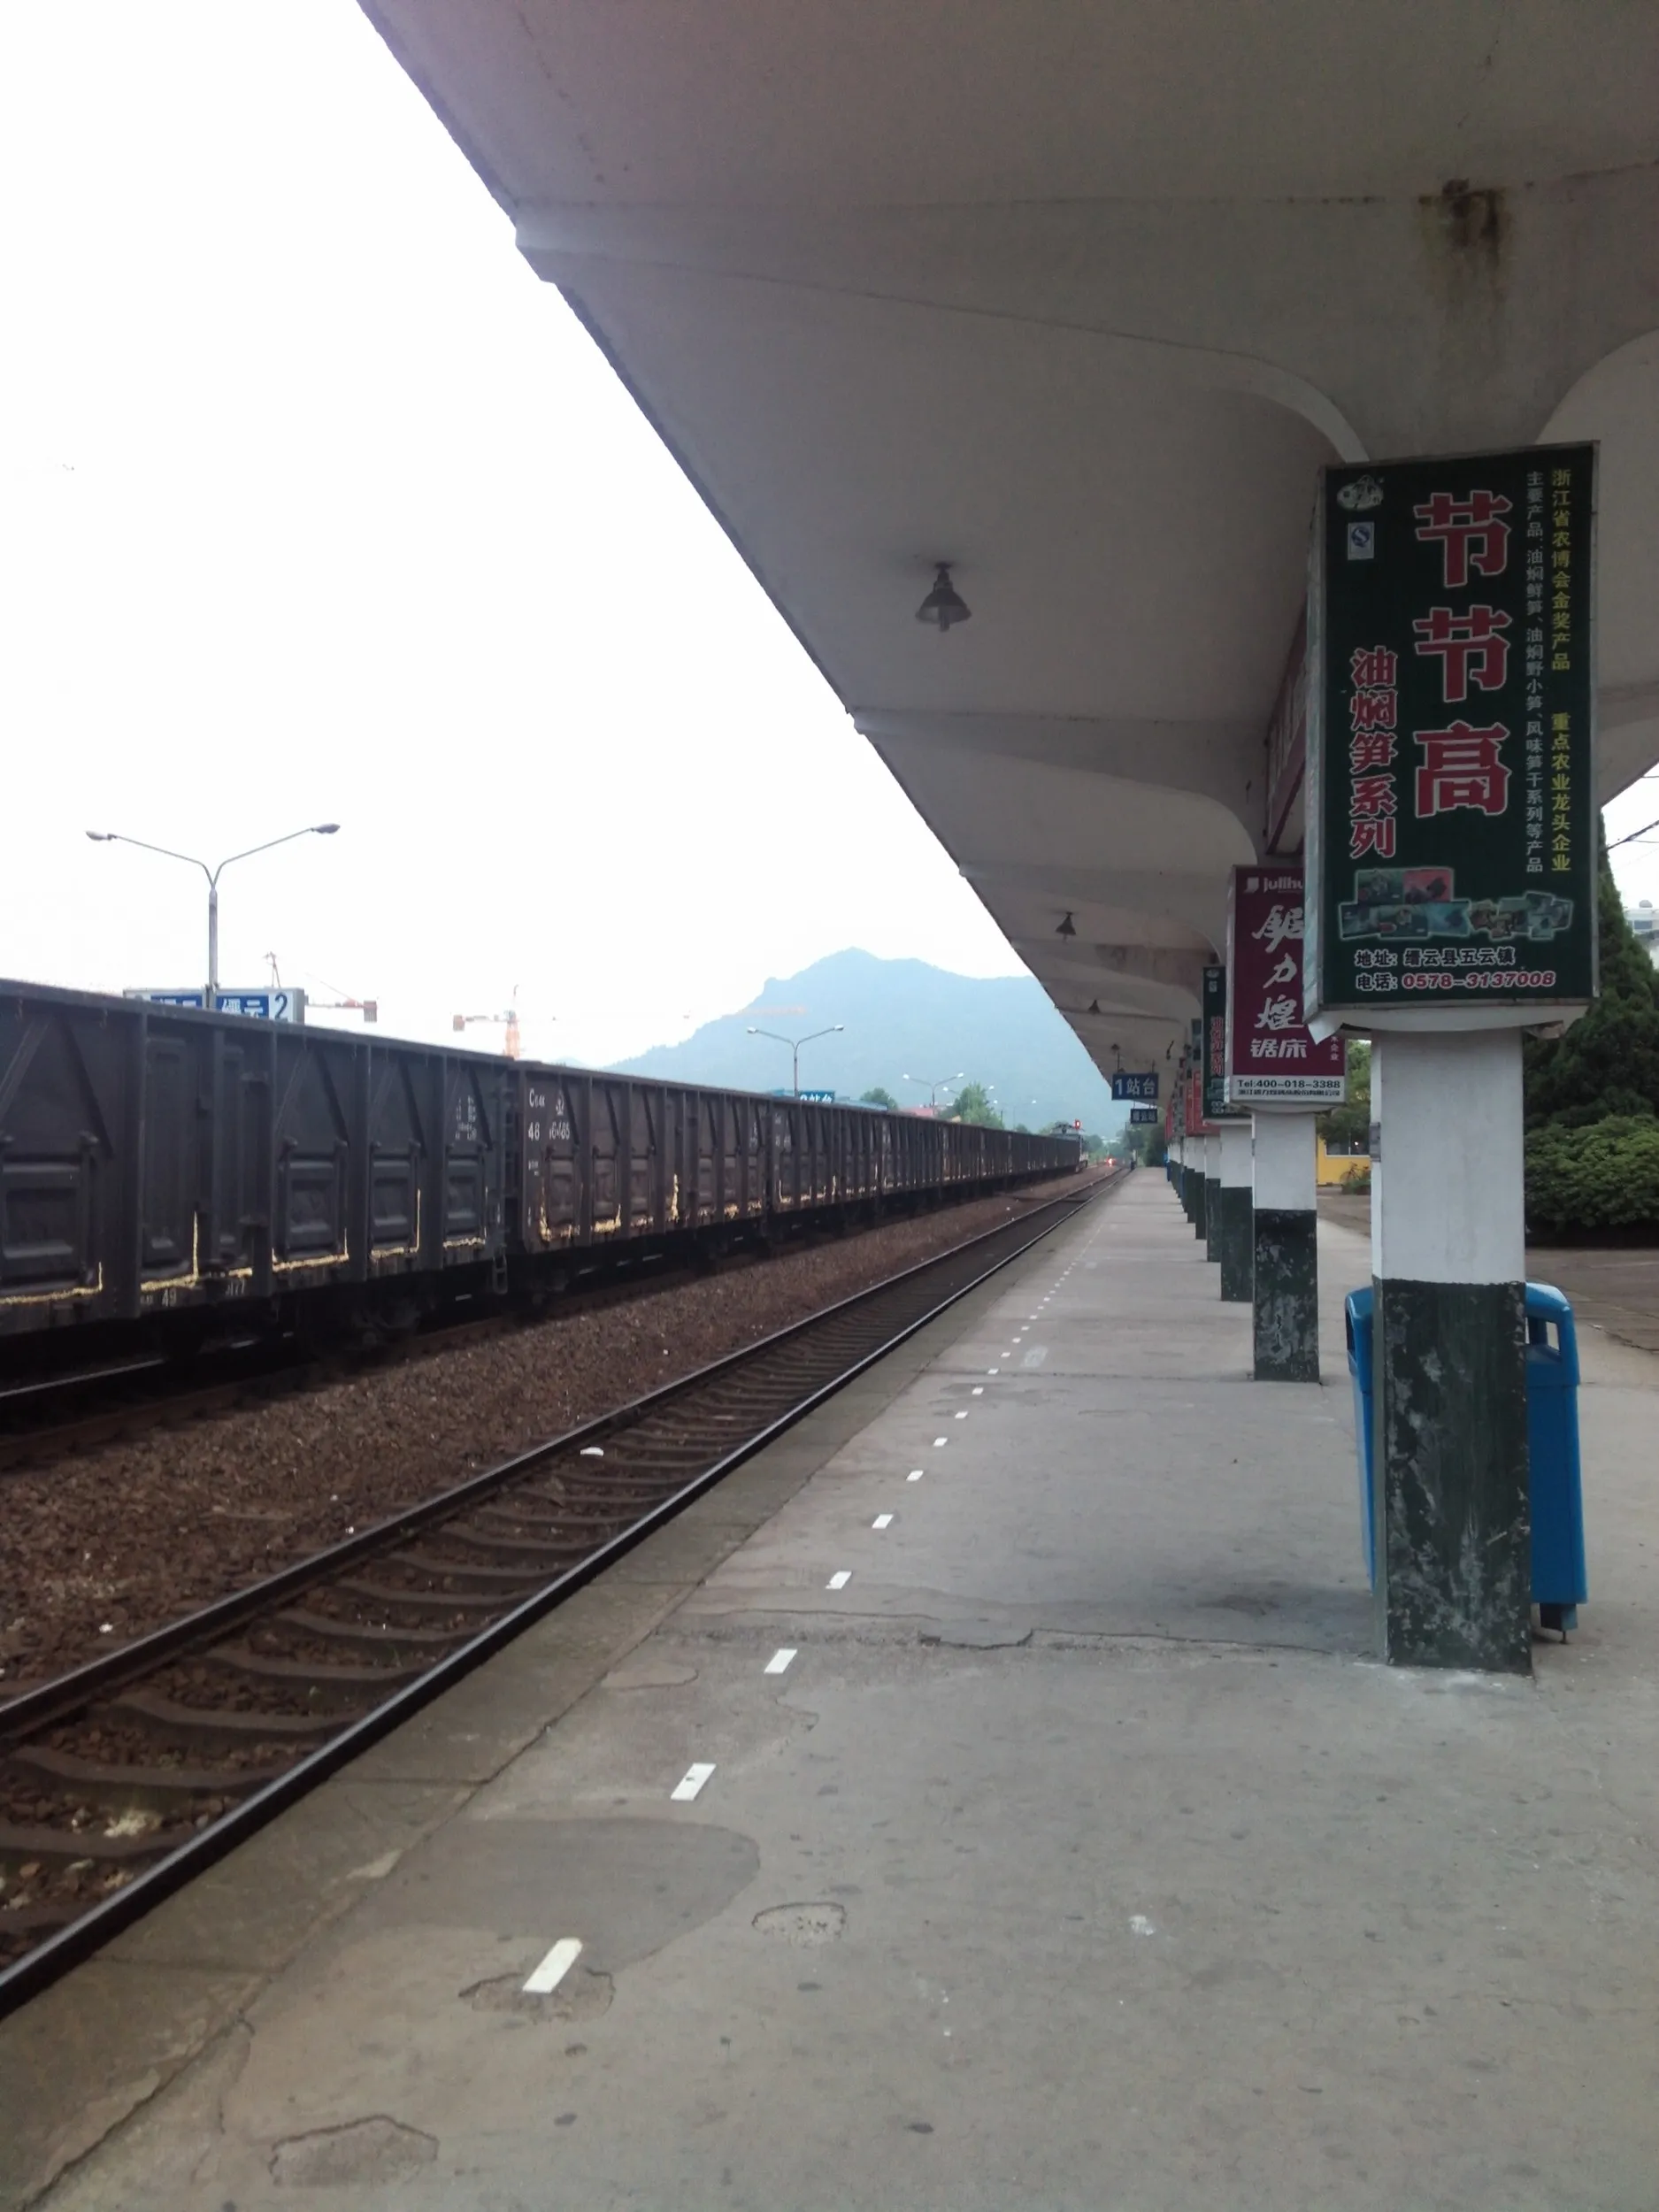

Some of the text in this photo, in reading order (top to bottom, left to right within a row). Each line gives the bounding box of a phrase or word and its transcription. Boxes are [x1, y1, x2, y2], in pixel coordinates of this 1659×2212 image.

[1413, 489, 1514, 818] 节节高
[1551, 469, 1571, 671] 浙江省农博会金奖产品
[1349, 645, 1398, 859] 油焖笋系列
[1551, 711, 1572, 872] 重点农业龙头企业
[1250, 1038, 1308, 1059] 锯床
